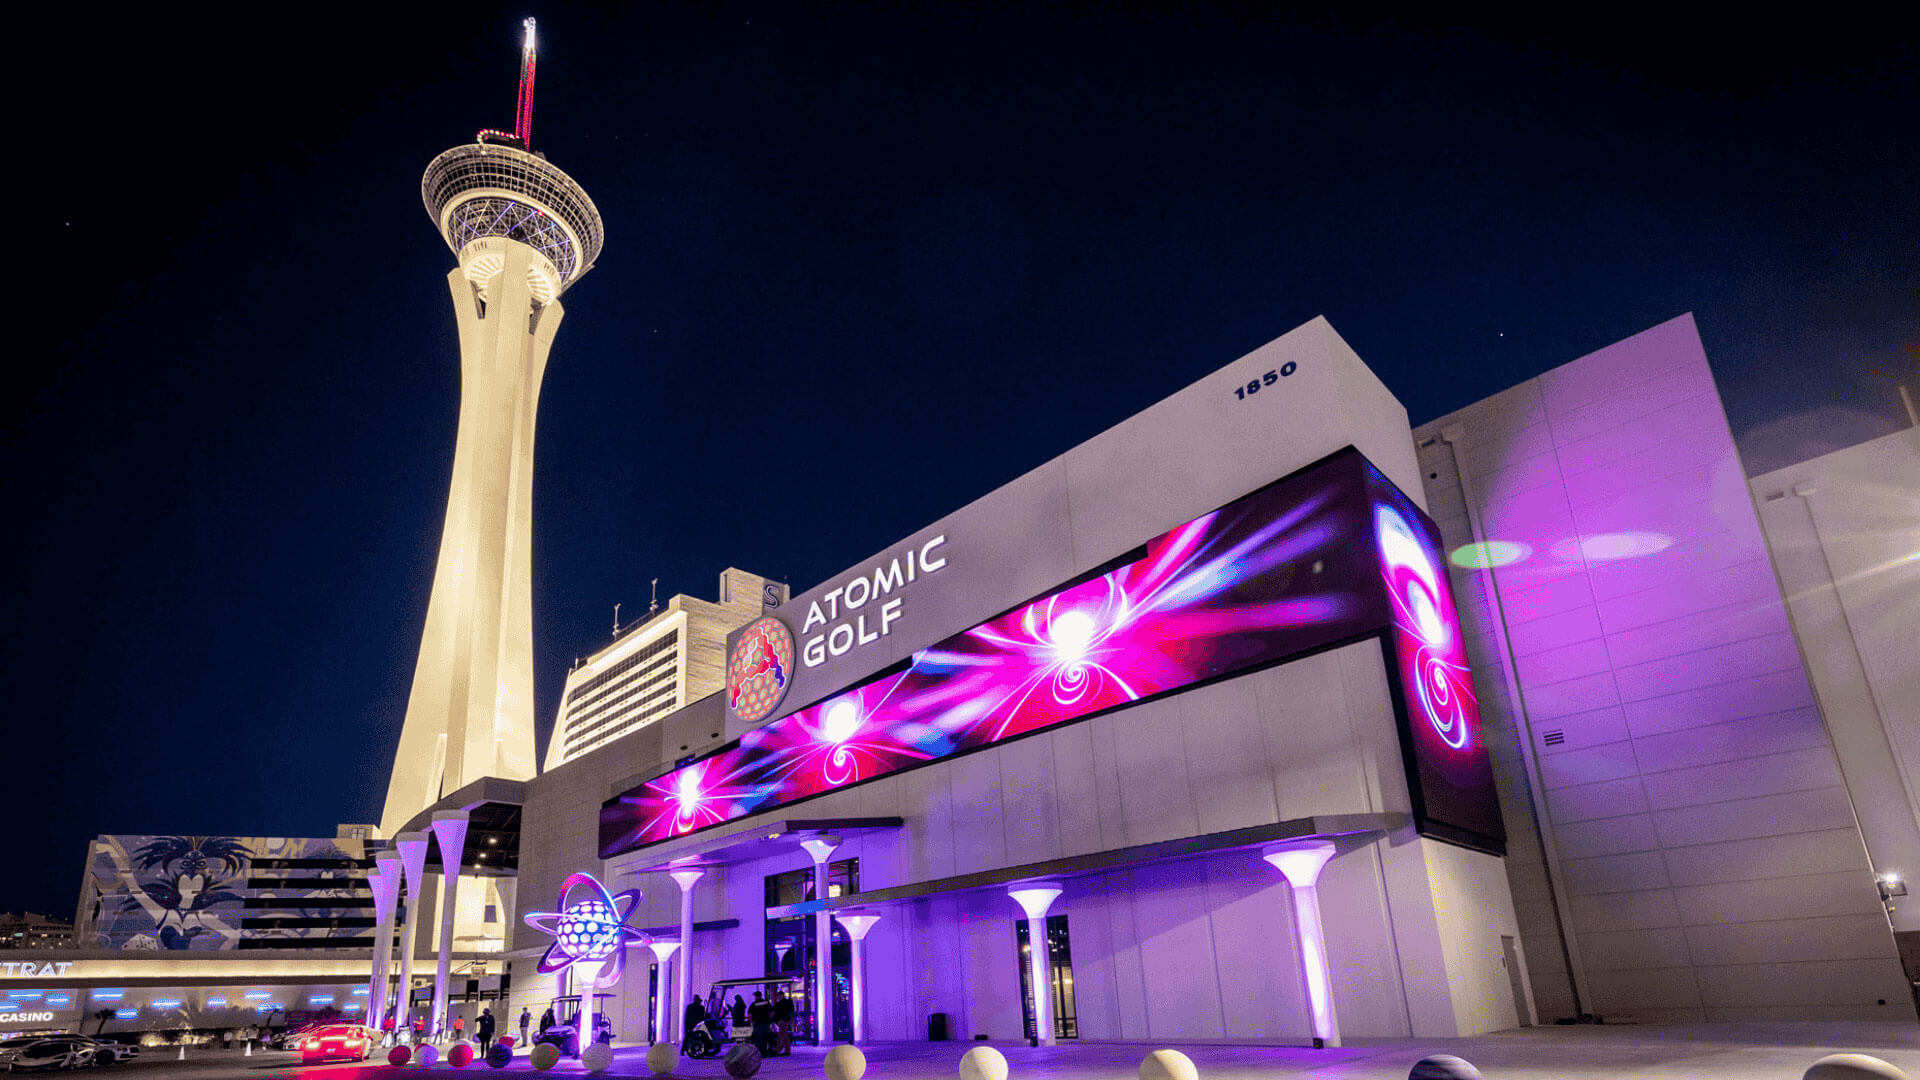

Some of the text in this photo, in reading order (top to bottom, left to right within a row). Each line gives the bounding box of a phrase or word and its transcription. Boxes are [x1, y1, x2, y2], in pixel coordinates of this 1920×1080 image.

[1234, 361, 1297, 400] 1850
[802, 535, 947, 634] ATOMIC
[803, 598, 902, 667] GOLF
[0, 962, 73, 977] TRAT
[0, 1011, 54, 1022] CASINO
